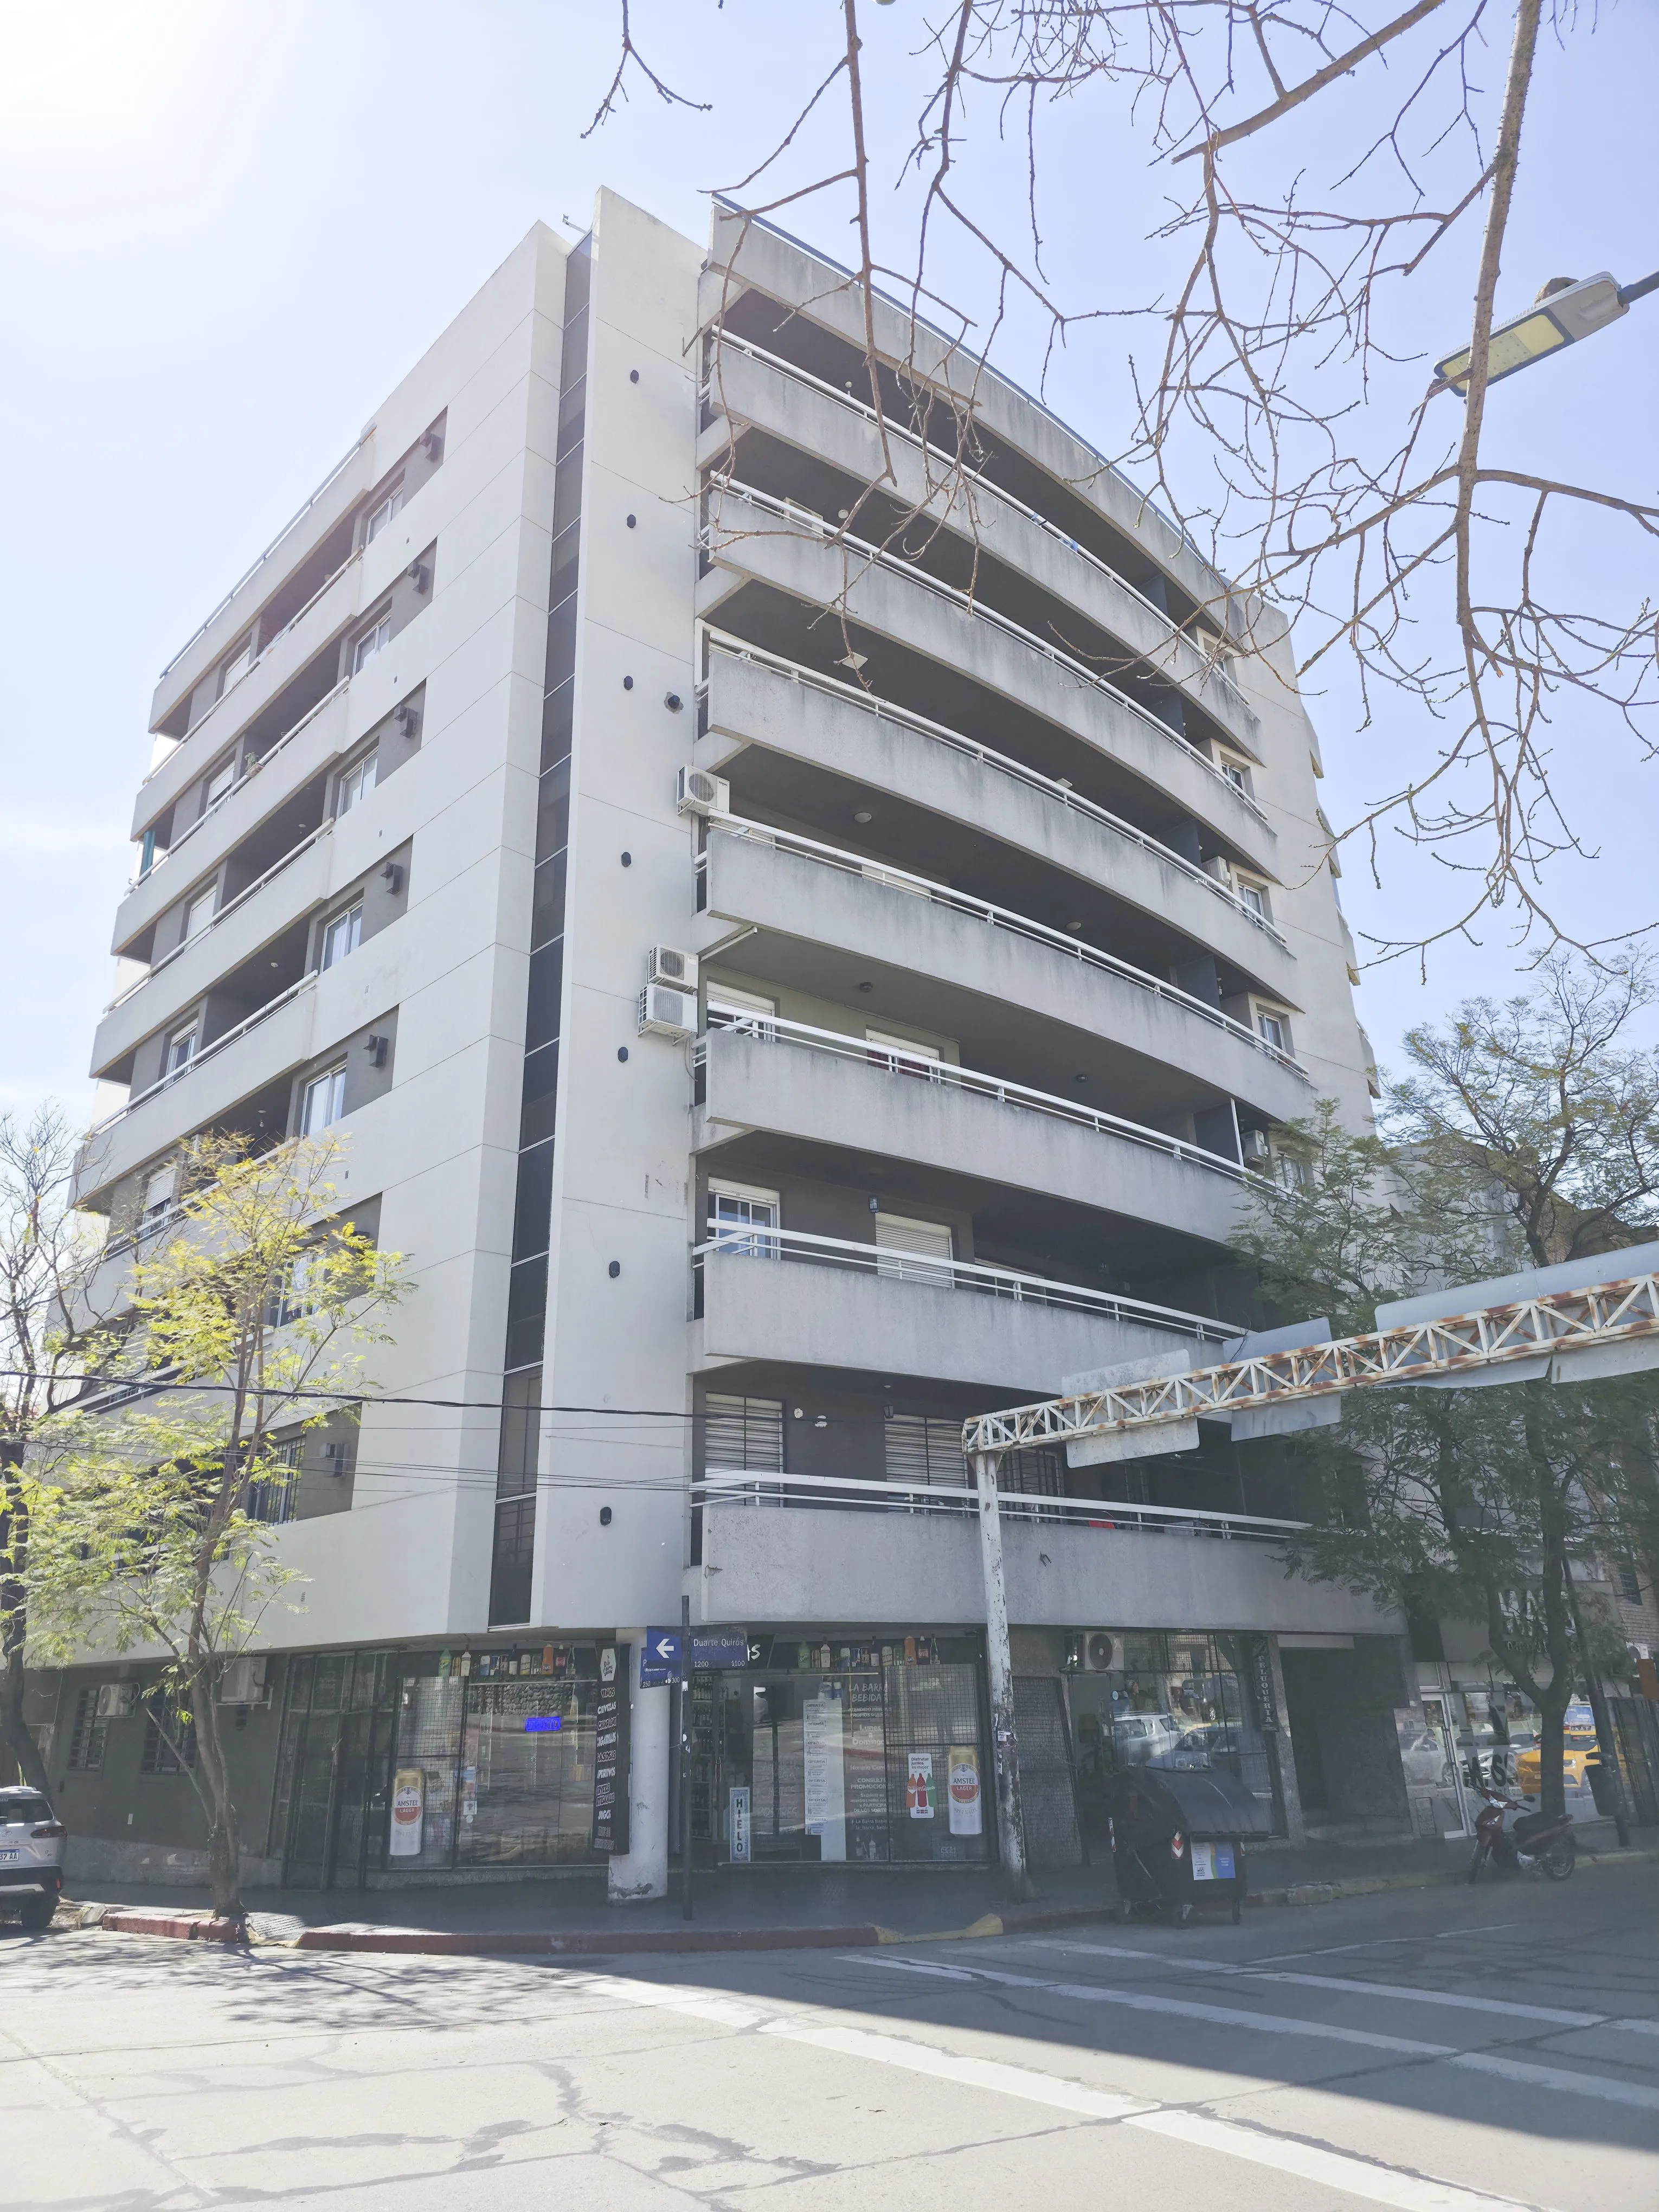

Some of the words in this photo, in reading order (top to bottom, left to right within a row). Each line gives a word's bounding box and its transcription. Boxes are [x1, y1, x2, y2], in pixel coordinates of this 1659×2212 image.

[721, 1637, 744, 1648] Quirós
[601, 1687, 615, 1698] VINOS
[1258, 1655, 1273, 1722] PELUQUERIA
